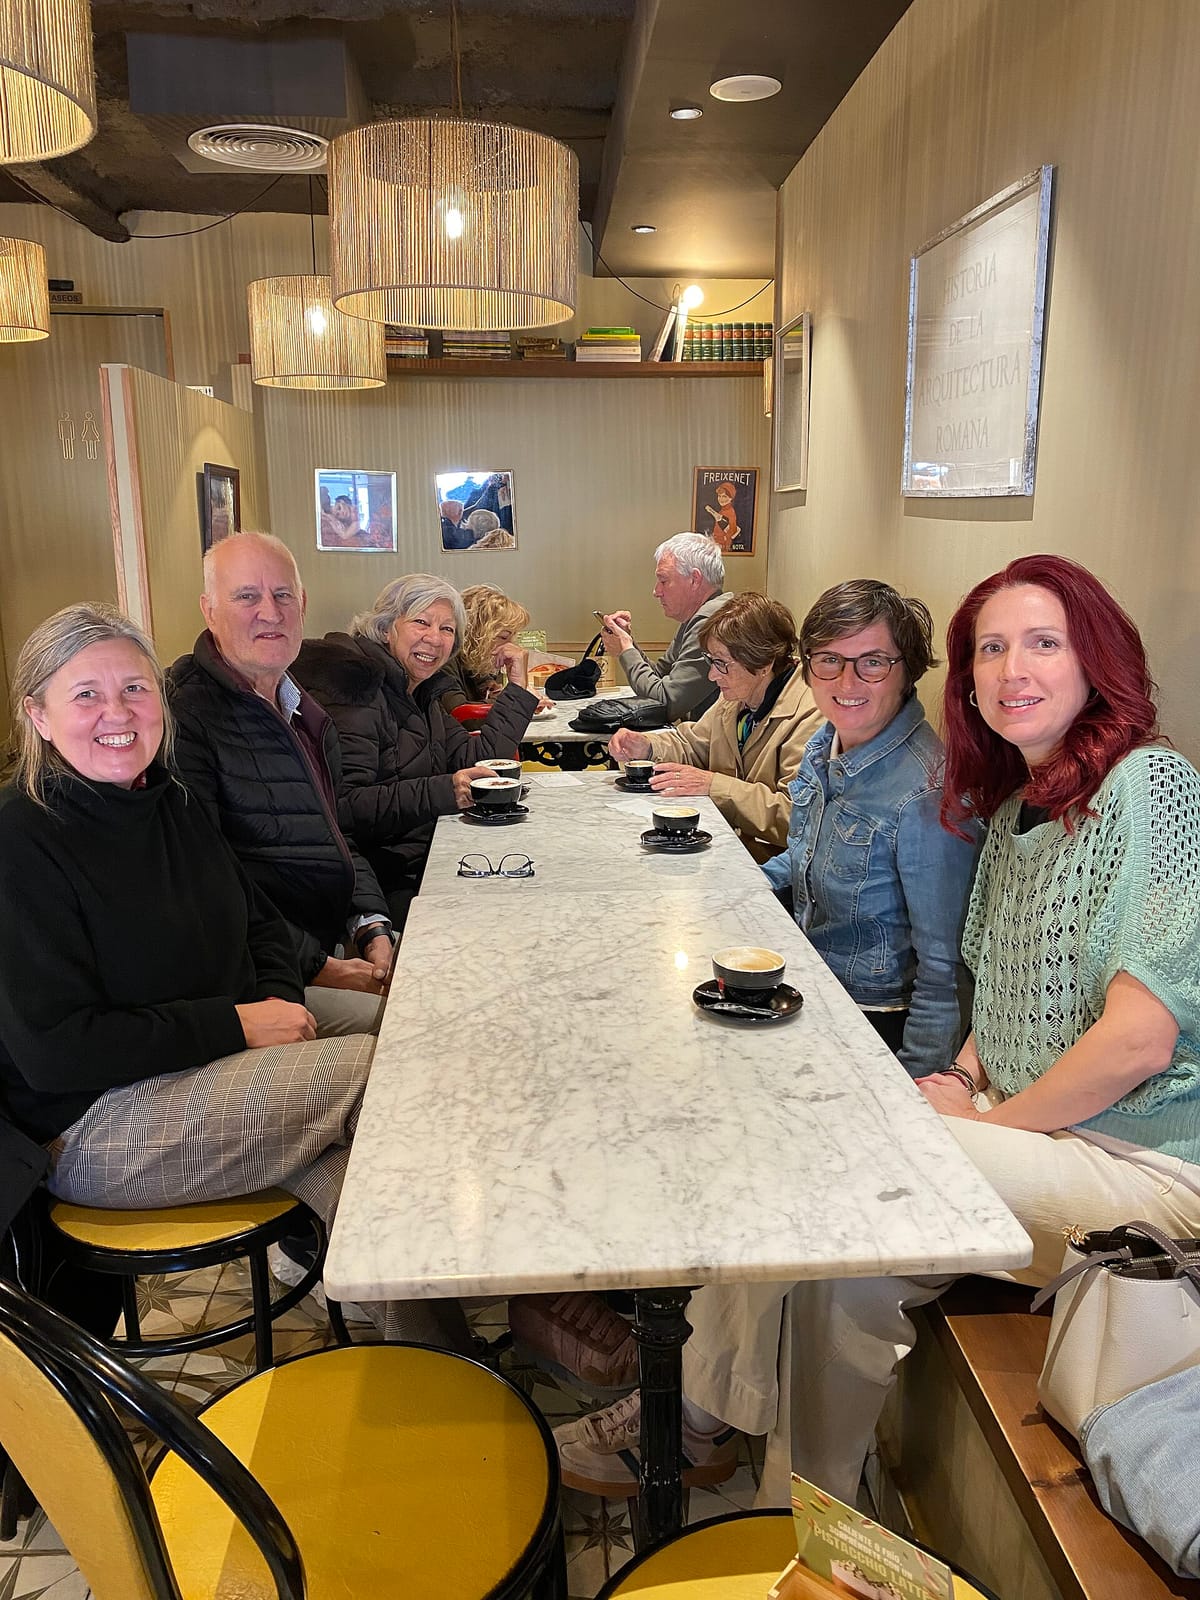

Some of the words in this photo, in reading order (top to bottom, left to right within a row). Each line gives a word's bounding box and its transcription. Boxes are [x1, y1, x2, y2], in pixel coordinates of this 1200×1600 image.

[943, 252, 998, 306] HISTORIA
[950, 319, 964, 346] DE
[970, 310, 983, 338] LA
[918, 349, 1020, 408] ARQUITECTURA
[935, 416, 989, 454] ROMANA
[703, 472, 751, 486] FREIXENET
[837, 1520, 873, 1548] CALIENTE
[814, 1524, 887, 1577] PISTACCHIO
[890, 1571, 929, 1600] LATTE
[883, 1557, 900, 1573] CON
[901, 1567, 913, 1579] UN
